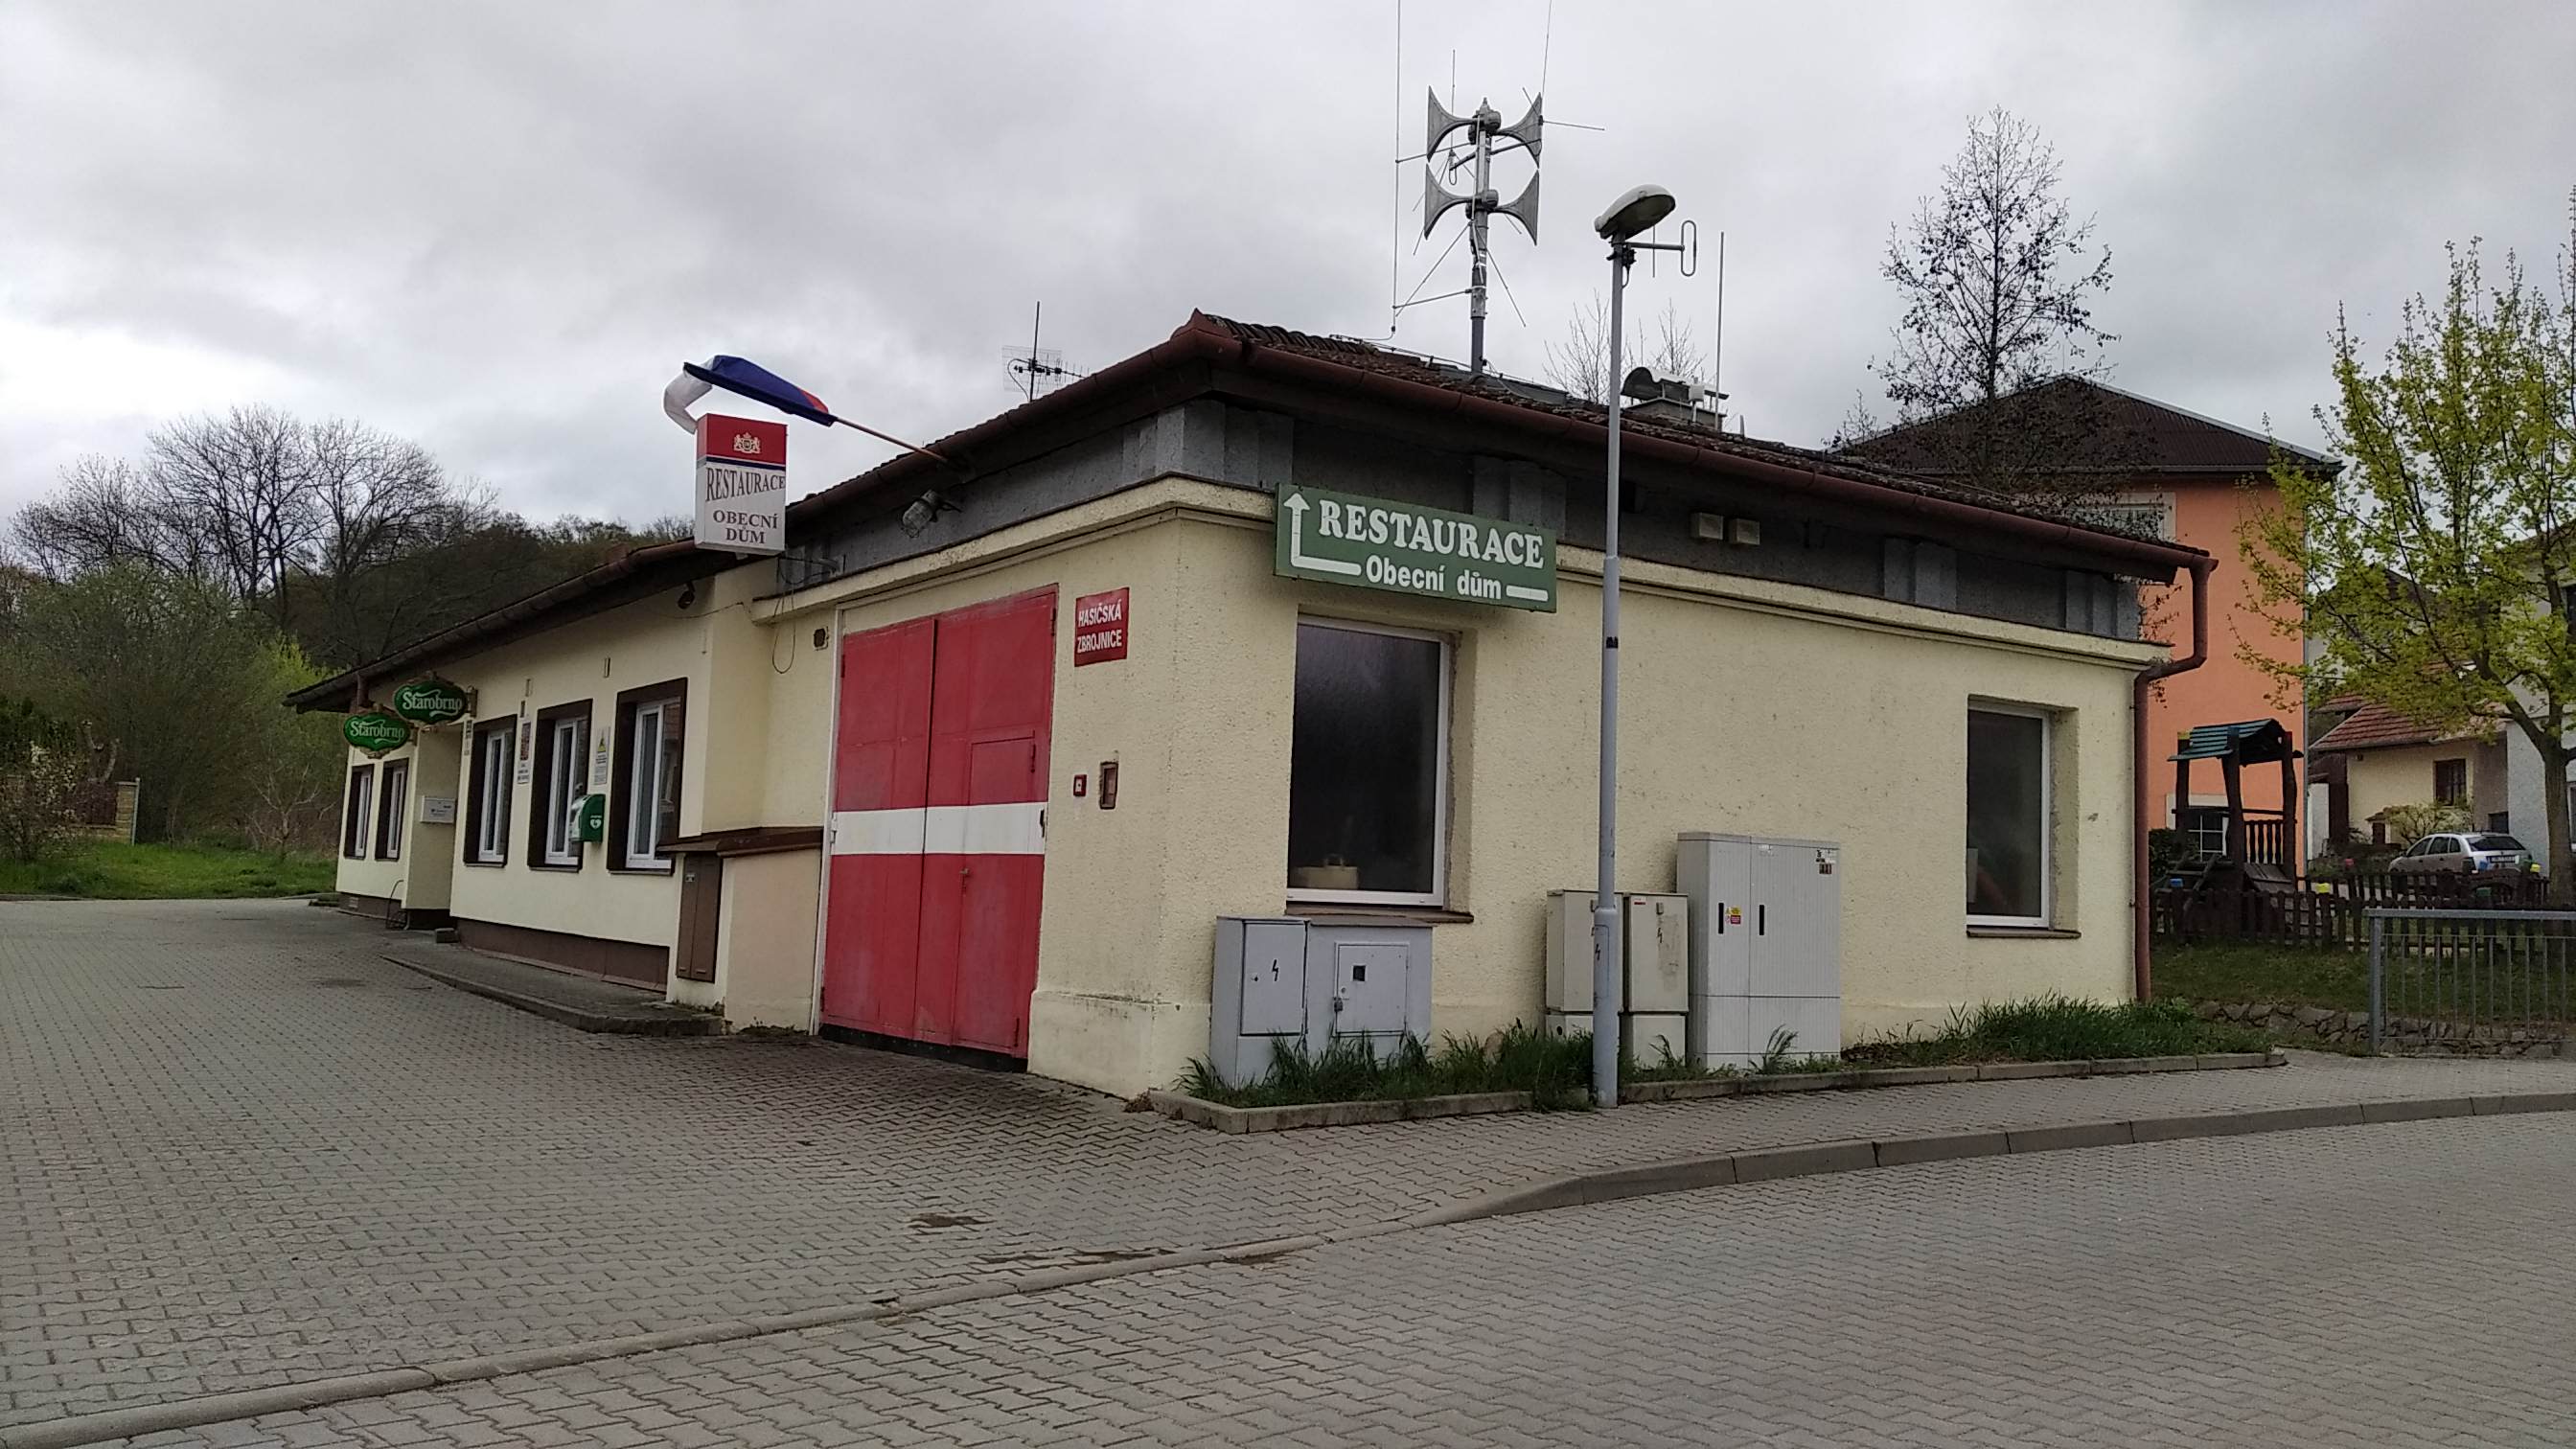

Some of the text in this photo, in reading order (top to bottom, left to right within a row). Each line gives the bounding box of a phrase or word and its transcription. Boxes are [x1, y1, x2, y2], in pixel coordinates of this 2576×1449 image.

[705, 467, 786, 502] RESTAURACE
[713, 510, 777, 529] OBECNÍ
[726, 526, 766, 544] DŮM
[1319, 499, 1544, 569] RESTAURACE
[1366, 555, 1502, 600] Obecní dům
[1078, 599, 1122, 627] HASIČSKÁ
[1077, 629, 1122, 653] ZBROJNICE
[402, 689, 463, 717] Starobrno
